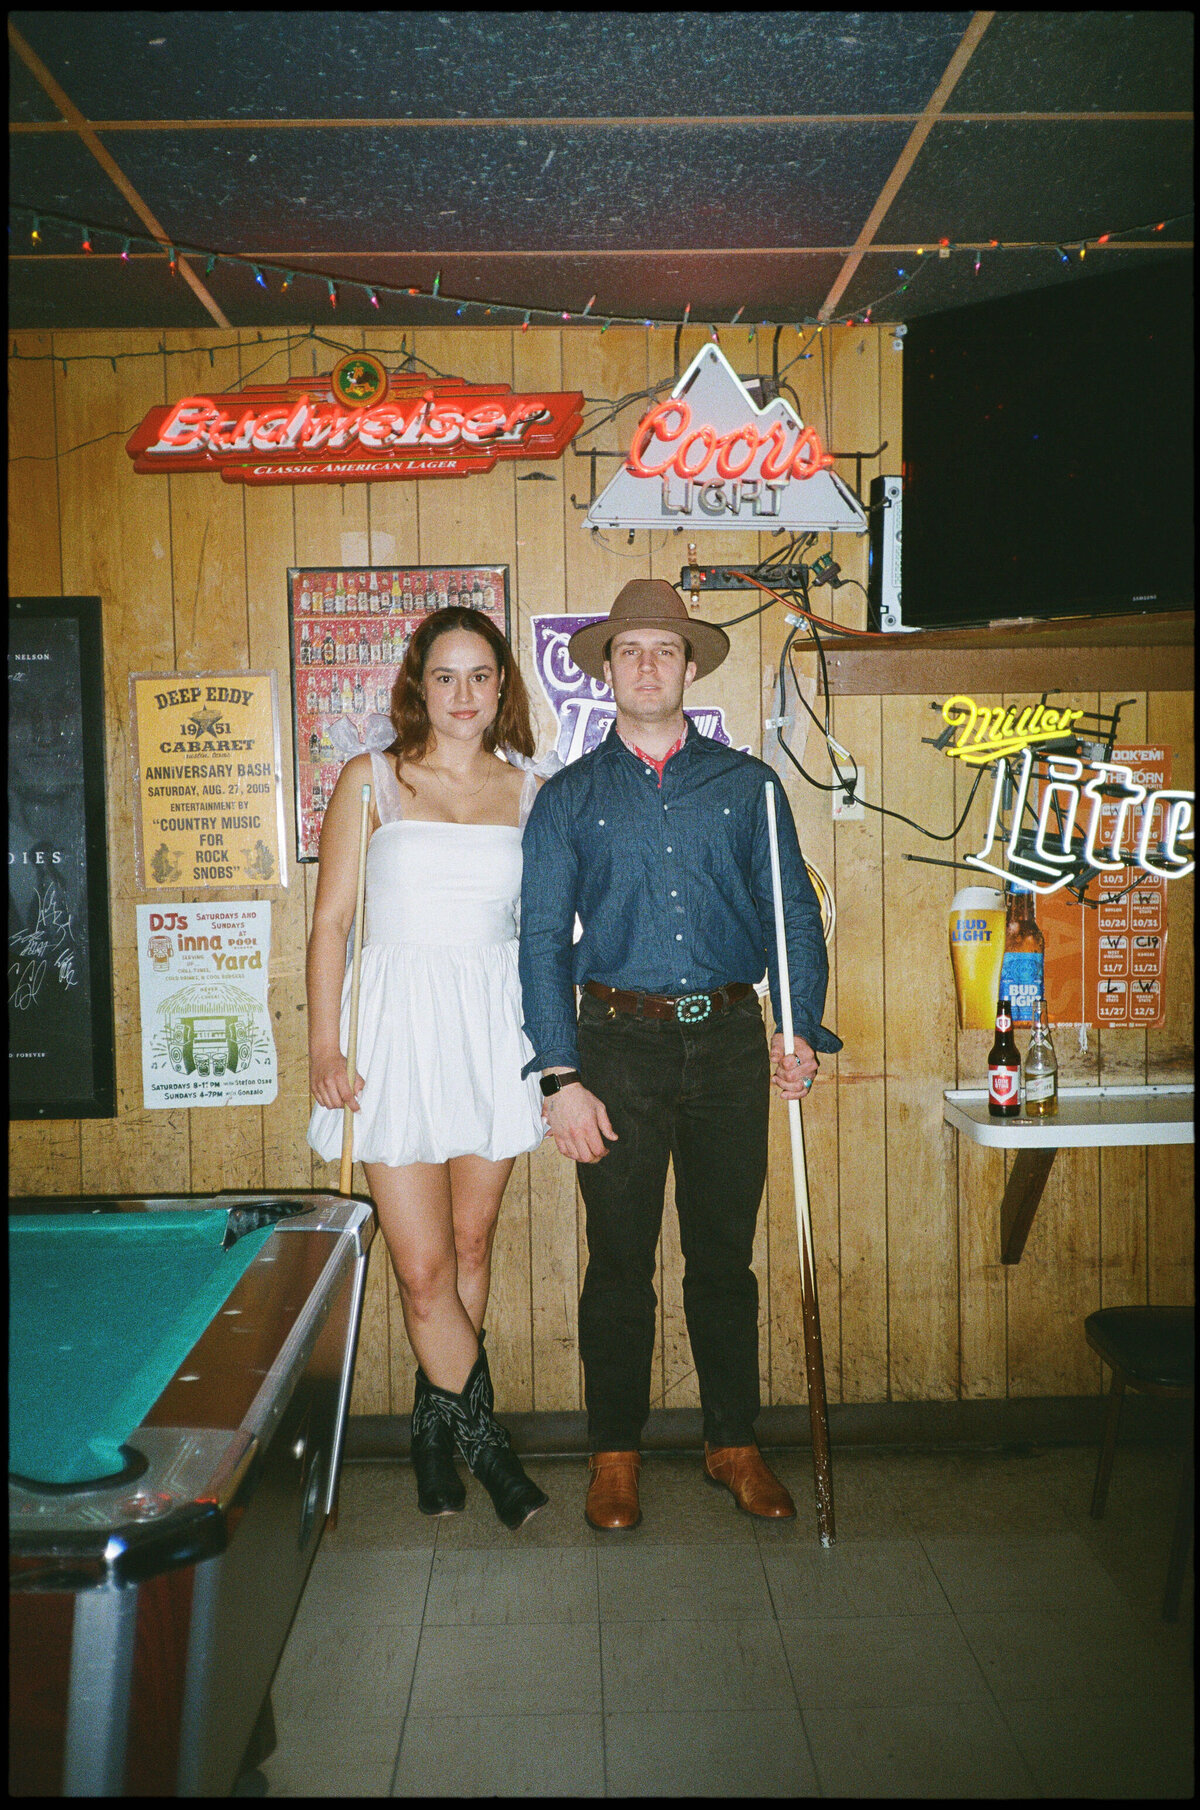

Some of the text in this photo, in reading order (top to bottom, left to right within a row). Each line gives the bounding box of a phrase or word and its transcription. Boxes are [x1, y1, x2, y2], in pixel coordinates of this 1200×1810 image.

[146, 395, 549, 454] Budweiser
[625, 399, 835, 480] Coors
[253, 459, 458, 475] CLASSIC AMERICAN LAGER
[15, 653, 50, 661] NELSON
[154, 686, 254, 710] DEEP EDDY
[942, 695, 1084, 747] Miller
[180, 722, 232, 736] 19 51
[159, 739, 256, 753] CABARET
[1111, 748, 1165, 761] OOK'EM!
[145, 763, 272, 780] ANNIVERSARY BASH
[147, 785, 200, 797] SATURDAY,
[202, 784, 225, 796] AUG.
[246, 783, 270, 794] 2005
[170, 801, 249, 812] ENTERTAINMENT BY
[152, 815, 261, 832] “COUNTRY MUSIC
[965, 746, 1195, 895] Lite
[199, 833, 224, 847] FOR
[195, 849, 230, 863] ROCK
[193, 865, 240, 880] SNOBS”
[149, 912, 189, 932] DJs
[196, 911, 257, 921] SATURDAYS AND
[211, 922, 245, 930] SUNDAYS
[956, 919, 987, 930] BUD
[1100, 919, 1126, 928] 10/24
[177, 933, 223, 952] inna
[227, 937, 258, 947] POOL
[952, 930, 993, 942] LIGHT
[1107, 935, 1122, 949] W
[1136, 936, 1159, 949] C19
[211, 950, 262, 971] Yard
[1103, 963, 1123, 973] 11/7
[1133, 963, 1158, 973] 11/21
[1008, 984, 1038, 996] BUD
[1107, 977, 1118, 994] L
[1139, 978, 1155, 994] W
[1099, 1007, 1125, 1017] 11/27
[1134, 1007, 1155, 1017] 12/5
[151, 1082, 190, 1092] SATURDAYS
[163, 1092, 197, 1101] SUNDAYS
[199, 1090, 223, 1098] 4-7PM
[237, 1089, 264, 1097] Gonzalo
